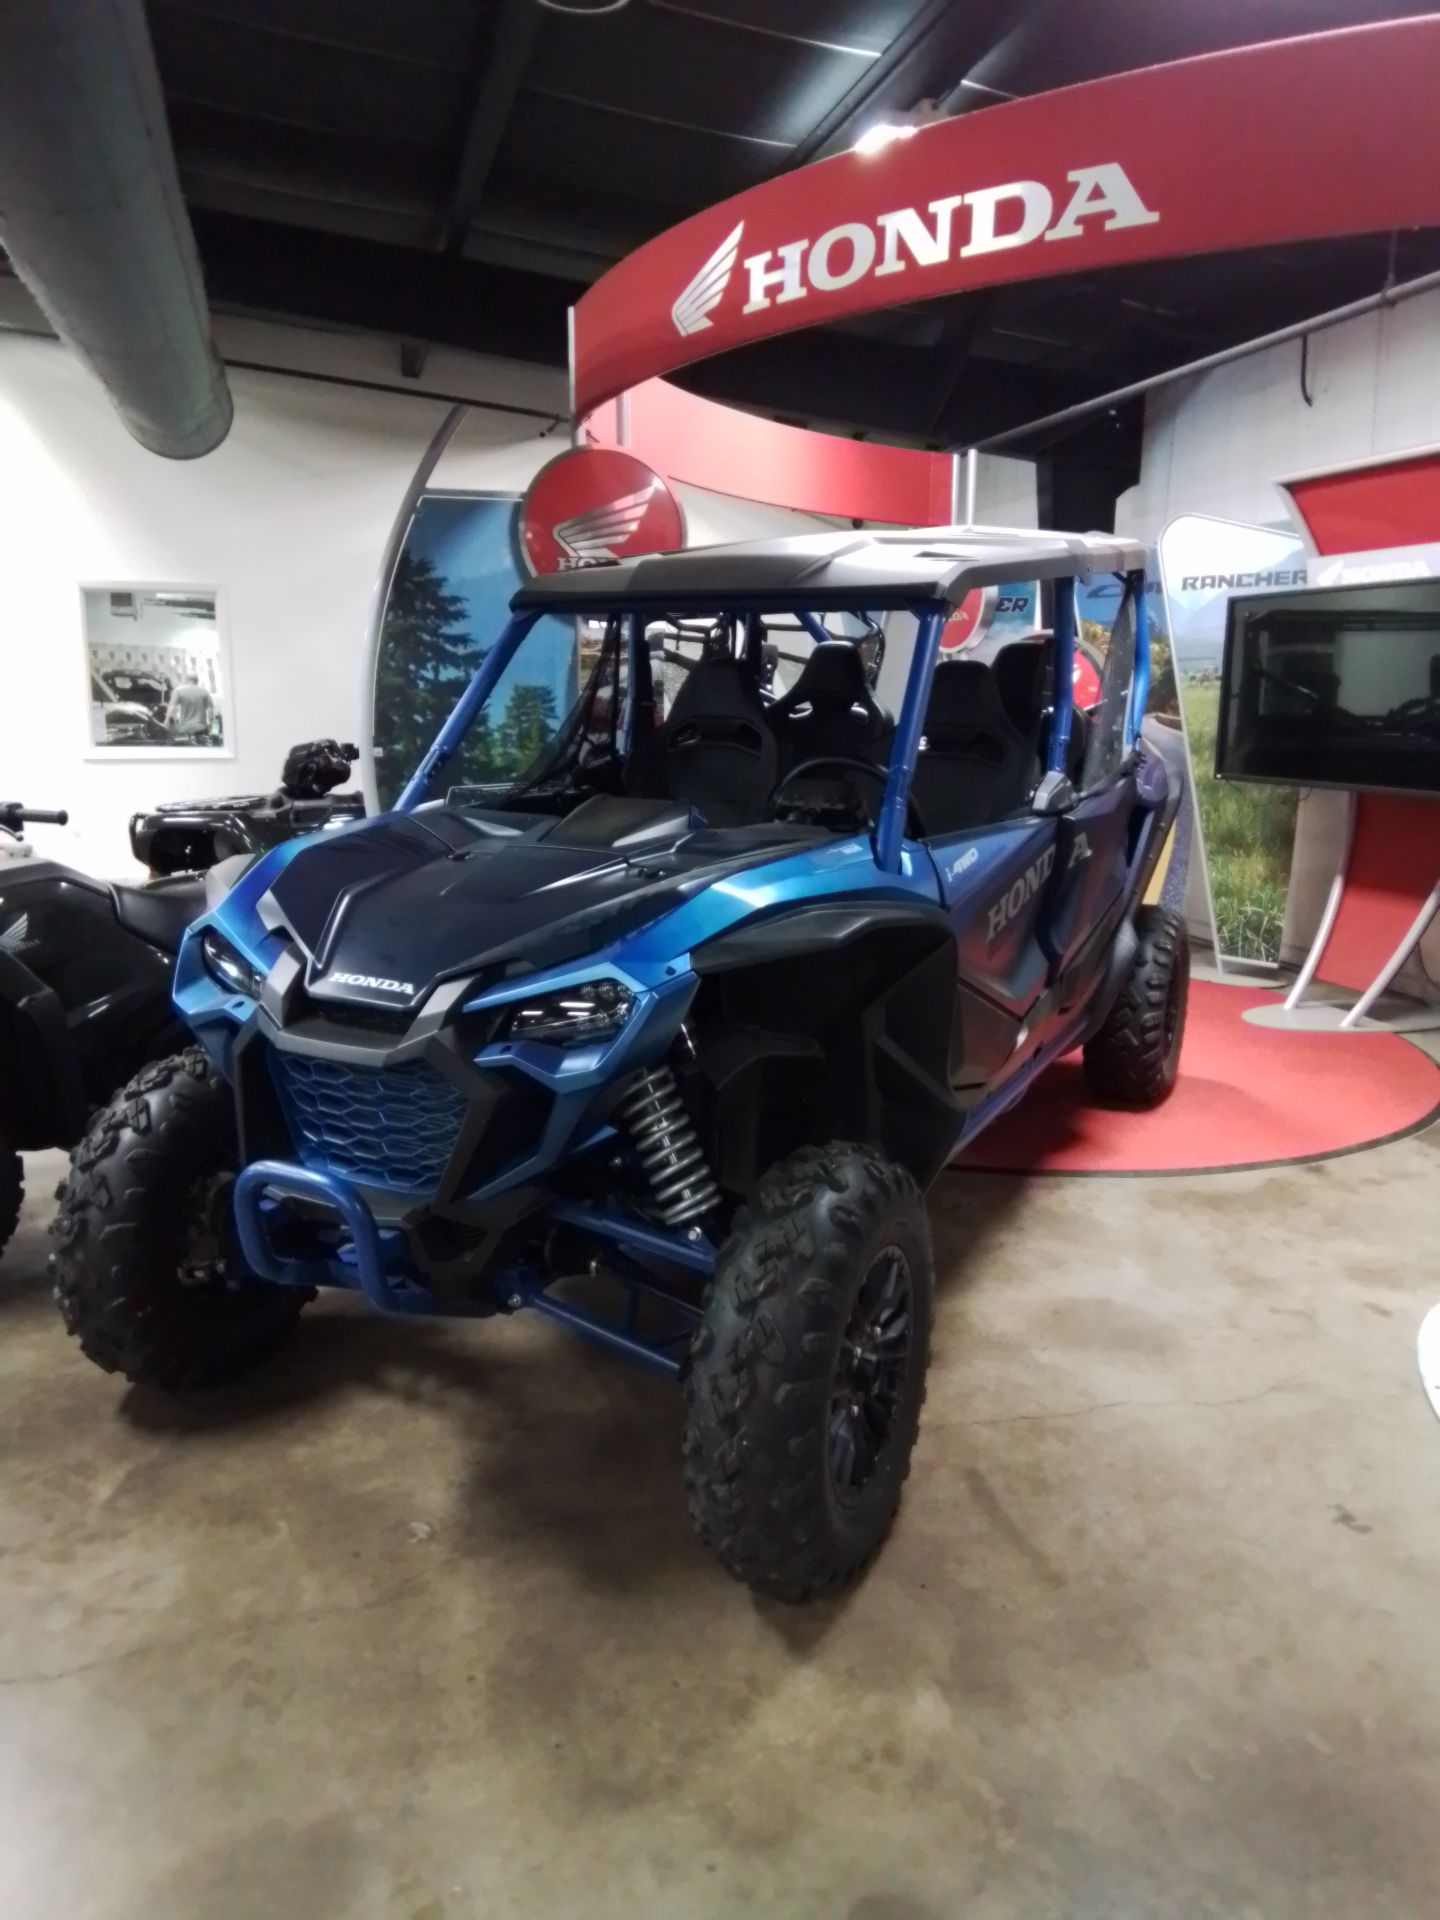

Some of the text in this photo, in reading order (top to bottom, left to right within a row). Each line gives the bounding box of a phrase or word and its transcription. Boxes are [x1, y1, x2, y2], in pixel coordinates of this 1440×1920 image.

[742, 162, 1160, 315] HONDA
[1181, 570, 1307, 591] RANCHER
[328, 972, 415, 995] HONDA
